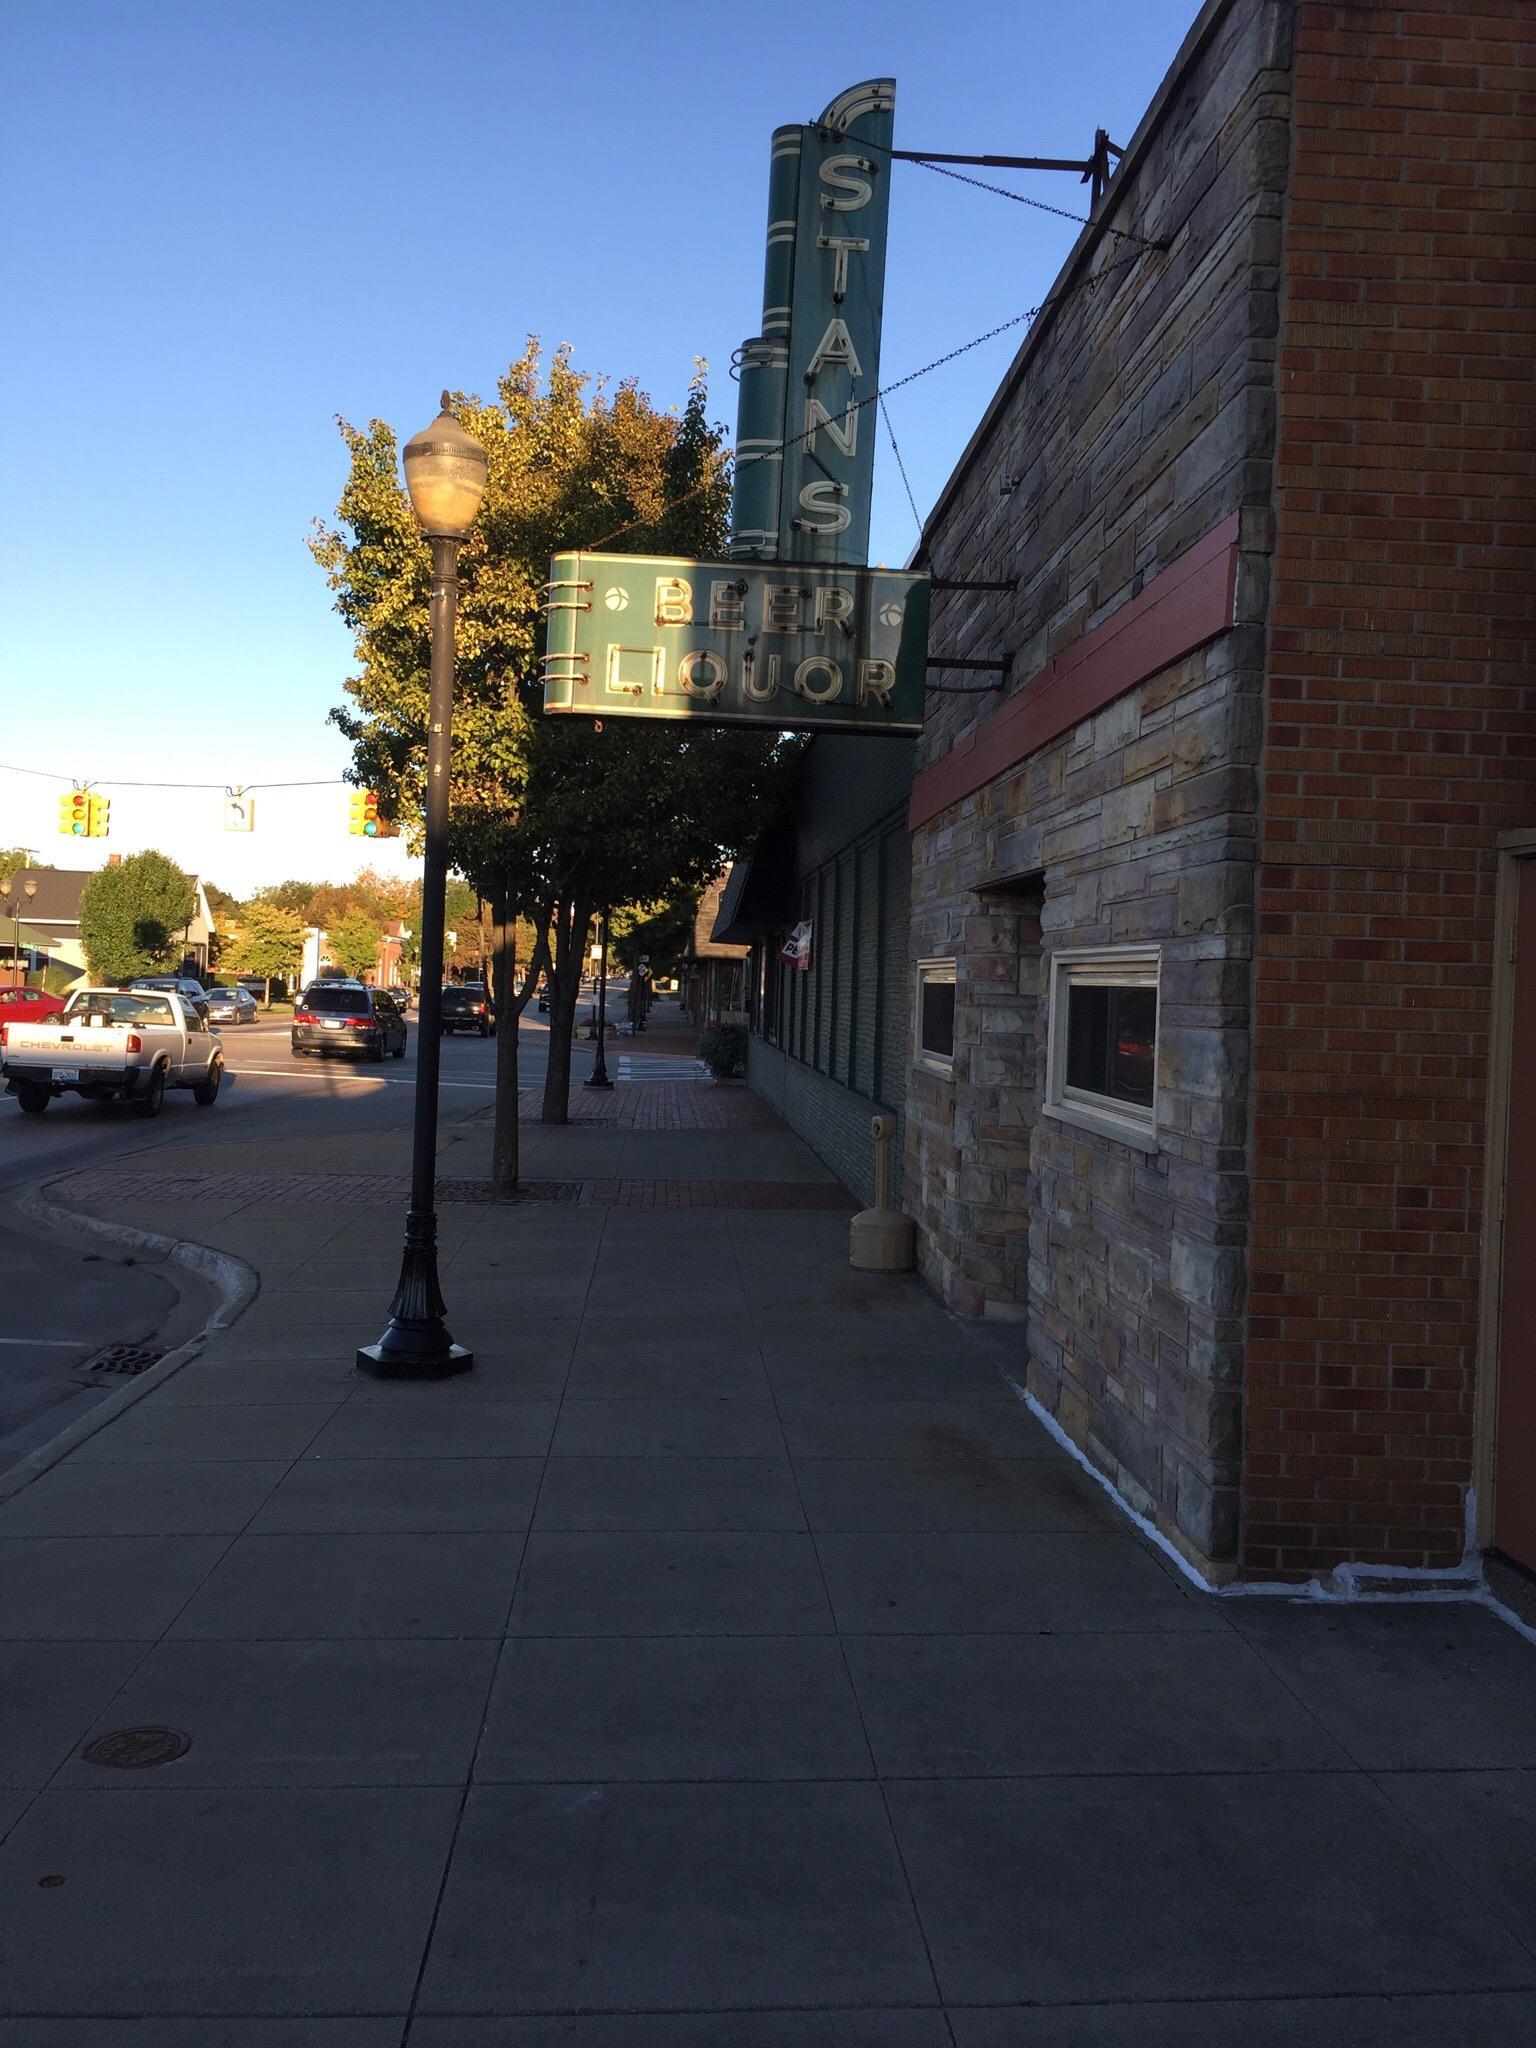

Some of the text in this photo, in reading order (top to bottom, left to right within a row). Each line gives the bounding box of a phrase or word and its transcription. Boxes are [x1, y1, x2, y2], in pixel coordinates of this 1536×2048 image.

[799, 154, 875, 536] STANS
[653, 576, 855, 637] BEER
[605, 643, 896, 708] LIQUOR
[20, 1040, 114, 1052] CHEVROLET
